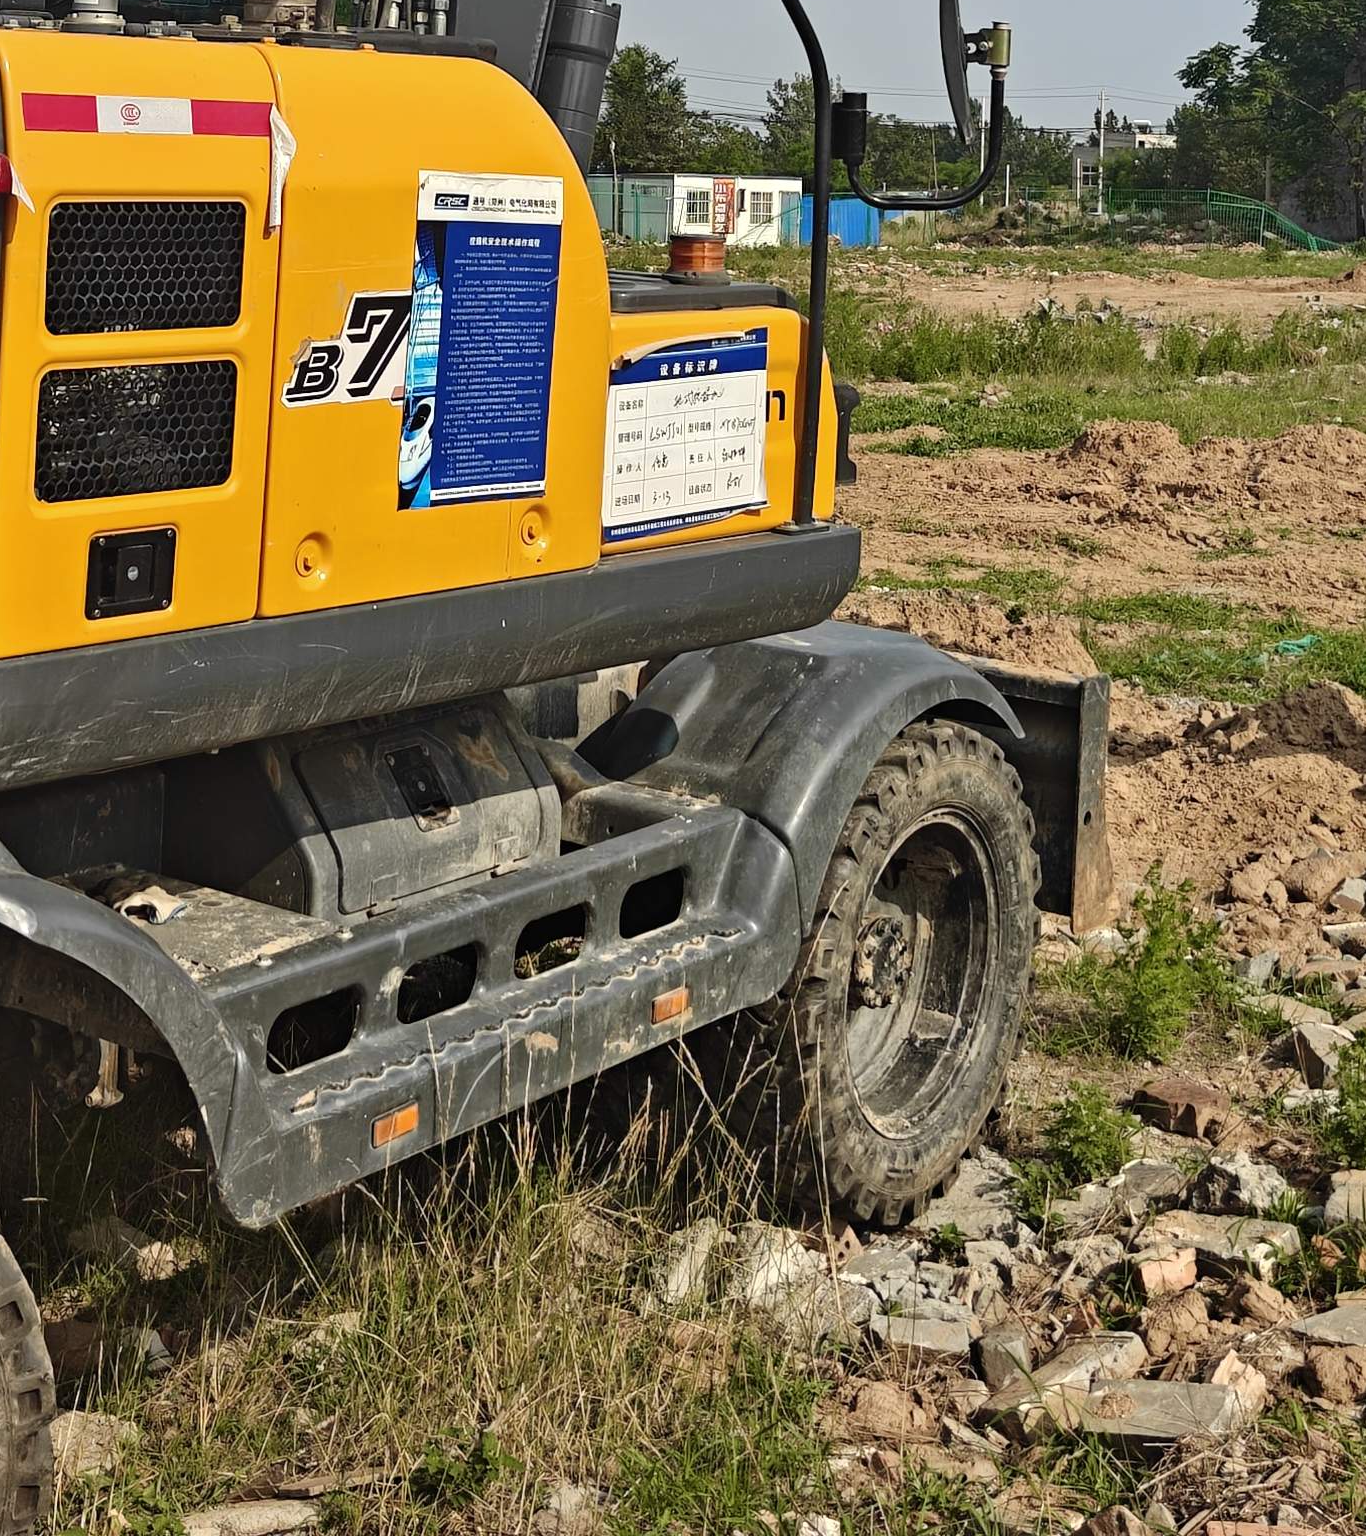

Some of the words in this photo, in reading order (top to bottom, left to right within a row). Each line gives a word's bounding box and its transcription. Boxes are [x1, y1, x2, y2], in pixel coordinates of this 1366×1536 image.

[437, 196, 467, 206] CRSC
[660, 358, 718, 376] 设备标识牌
[619, 399, 644, 412] 设备名称
